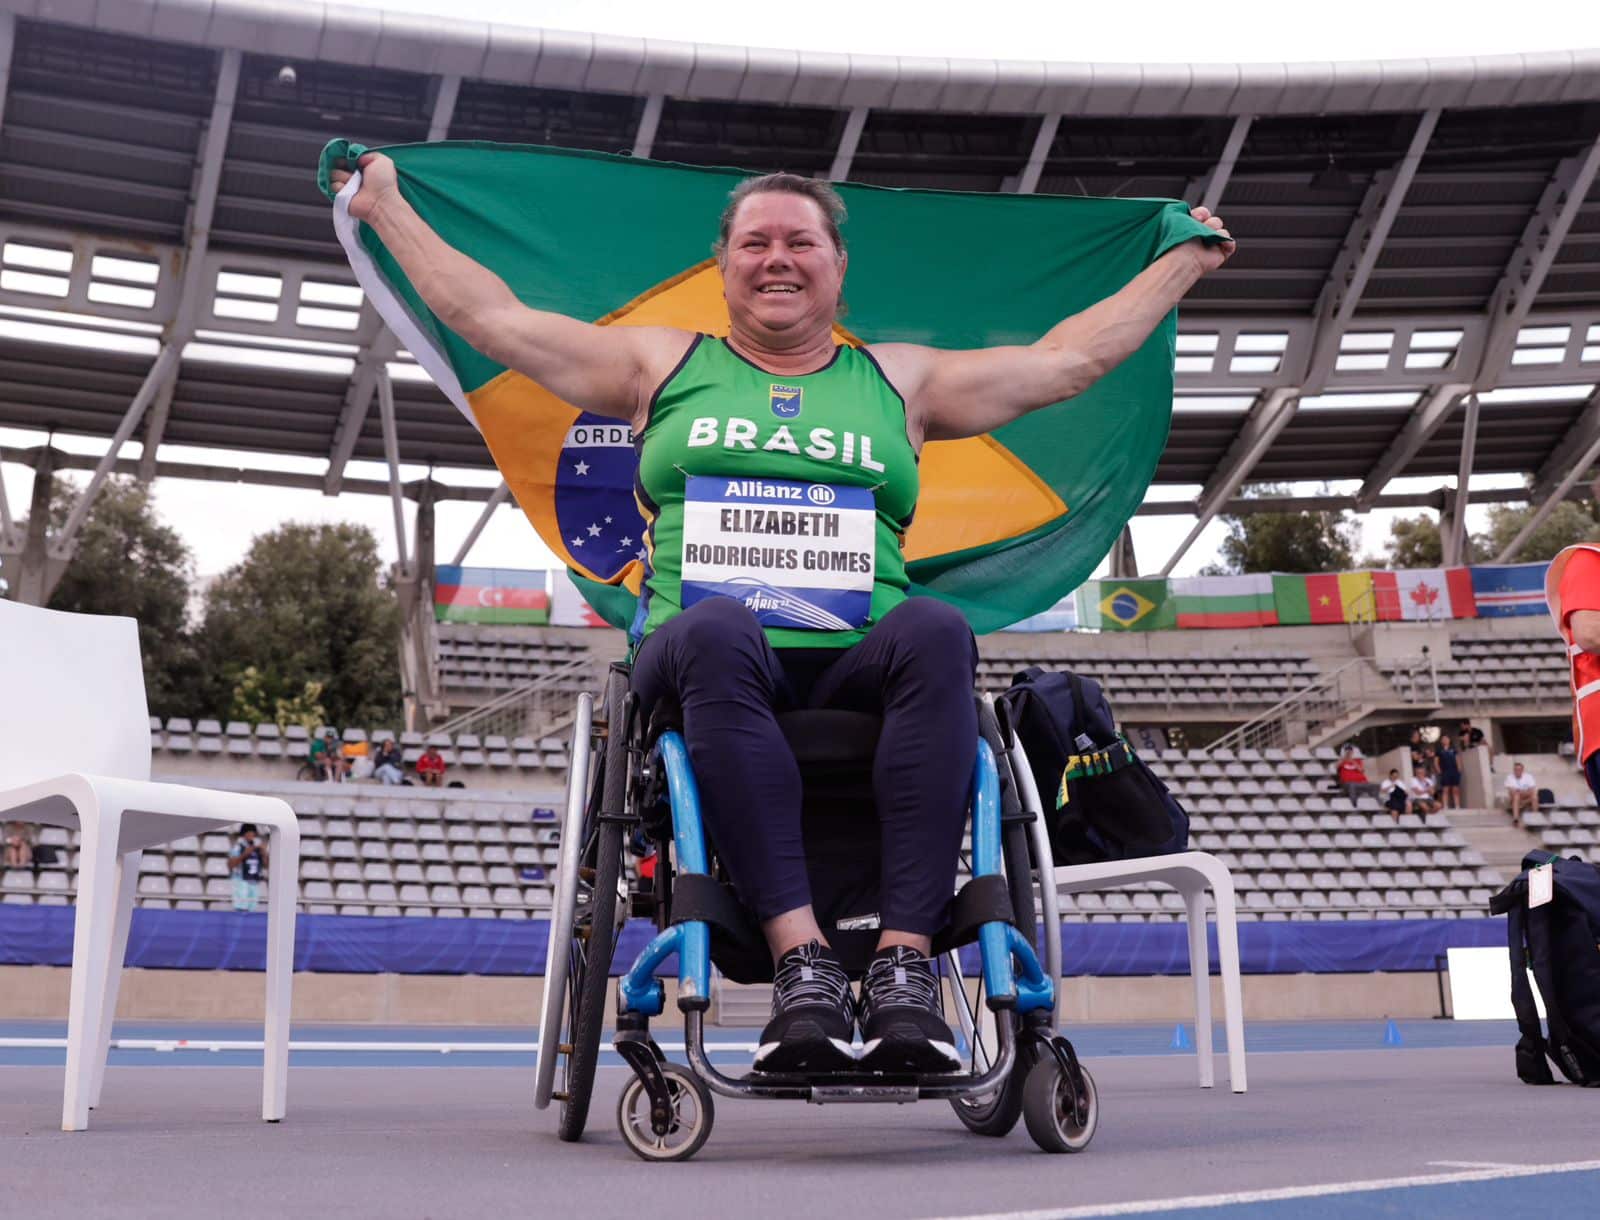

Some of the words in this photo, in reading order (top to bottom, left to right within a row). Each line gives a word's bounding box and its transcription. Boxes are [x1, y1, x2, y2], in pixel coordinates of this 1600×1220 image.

[687, 417, 885, 473] BRASIL
[724, 481, 803, 500] Allianz
[720, 508, 840, 537] ELIZABETH
[685, 543, 798, 570] RODRIGUES
[803, 550, 871, 573] GOMES
[745, 590, 778, 612] PARIS
